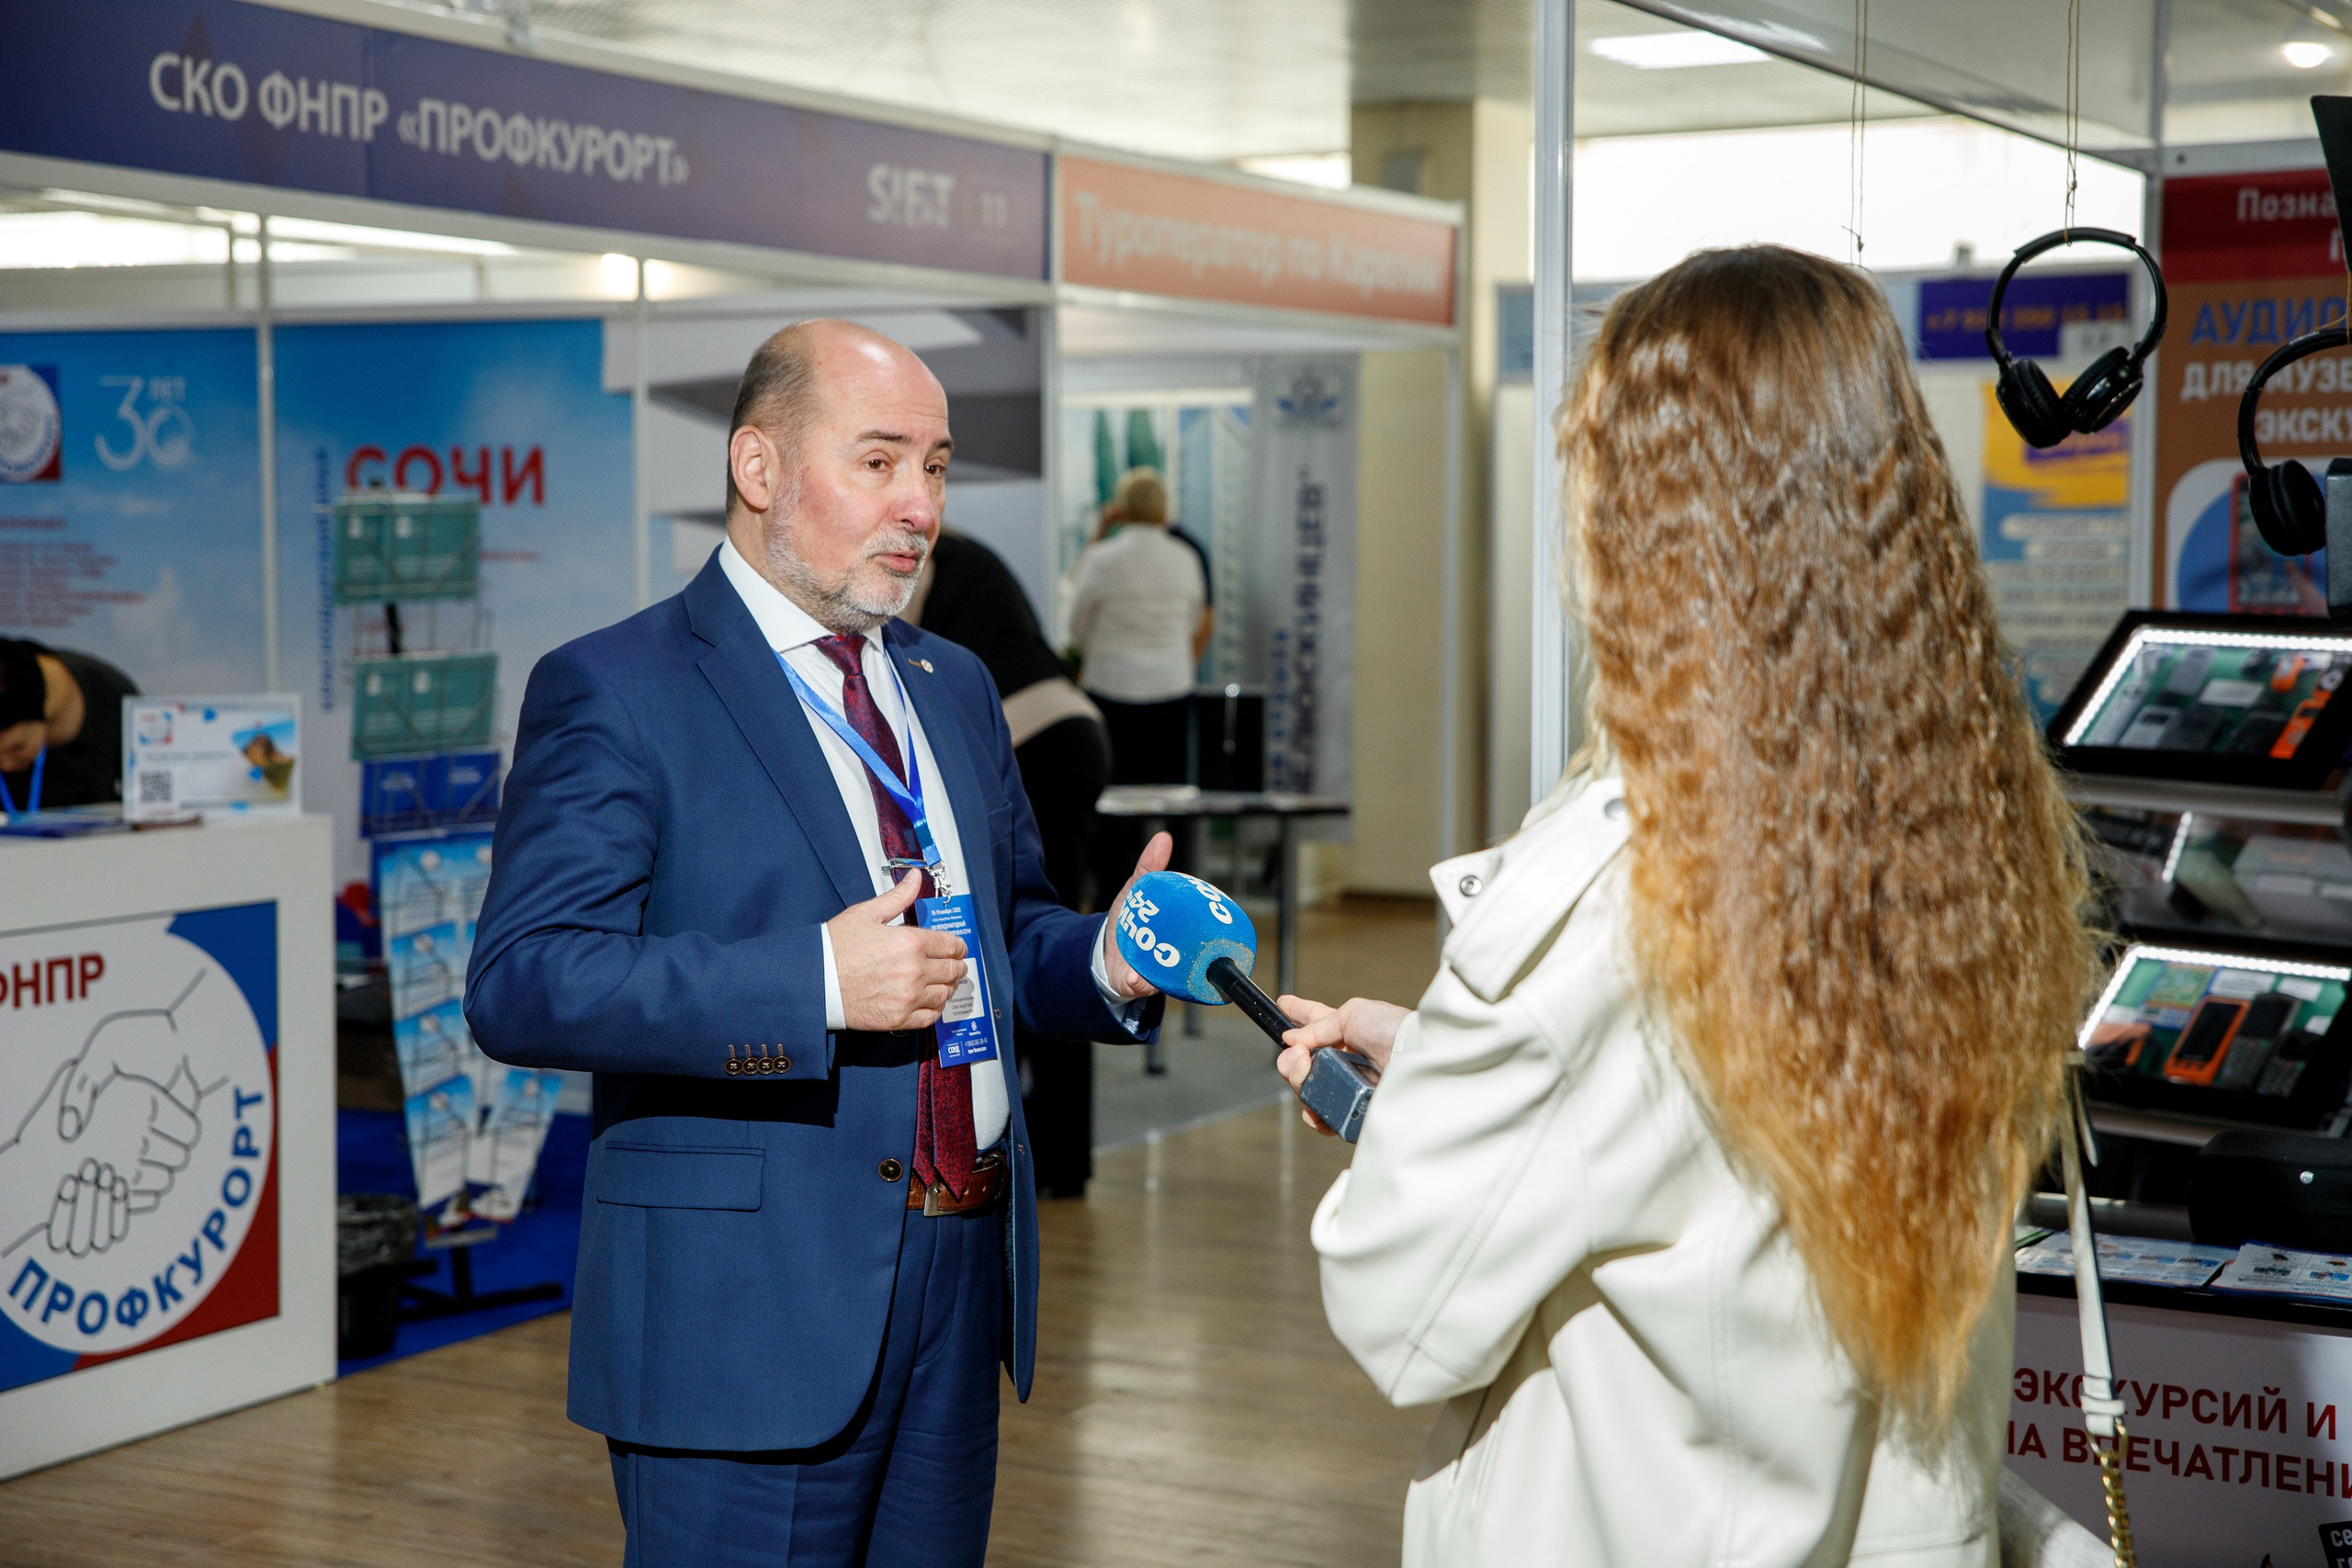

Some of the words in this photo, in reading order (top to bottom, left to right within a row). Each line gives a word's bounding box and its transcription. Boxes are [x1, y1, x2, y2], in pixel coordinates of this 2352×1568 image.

[150, 52, 248, 121] СКО
[258, 70, 390, 142] ФНПР
[398, 97, 689, 186] «ПРОФКУРОРТ»
[2236, 187, 2337, 222] Позна
[1073, 191, 1283, 288] Туроператор
[1287, 234, 1321, 280] по
[1327, 230, 1444, 303] Карелии
[2180, 359, 2255, 402] ДЛЯ
[94, 375, 196, 474] 30
[345, 445, 546, 506] СОЧИ
[1129, 889, 1160, 924] 24
[1178, 872, 1233, 925] СО
[1120, 900, 1181, 968] СОЧИ
[8, 1087, 264, 1337] ПРОФКУРОРТ
[2306, 1401, 2337, 1441] И
